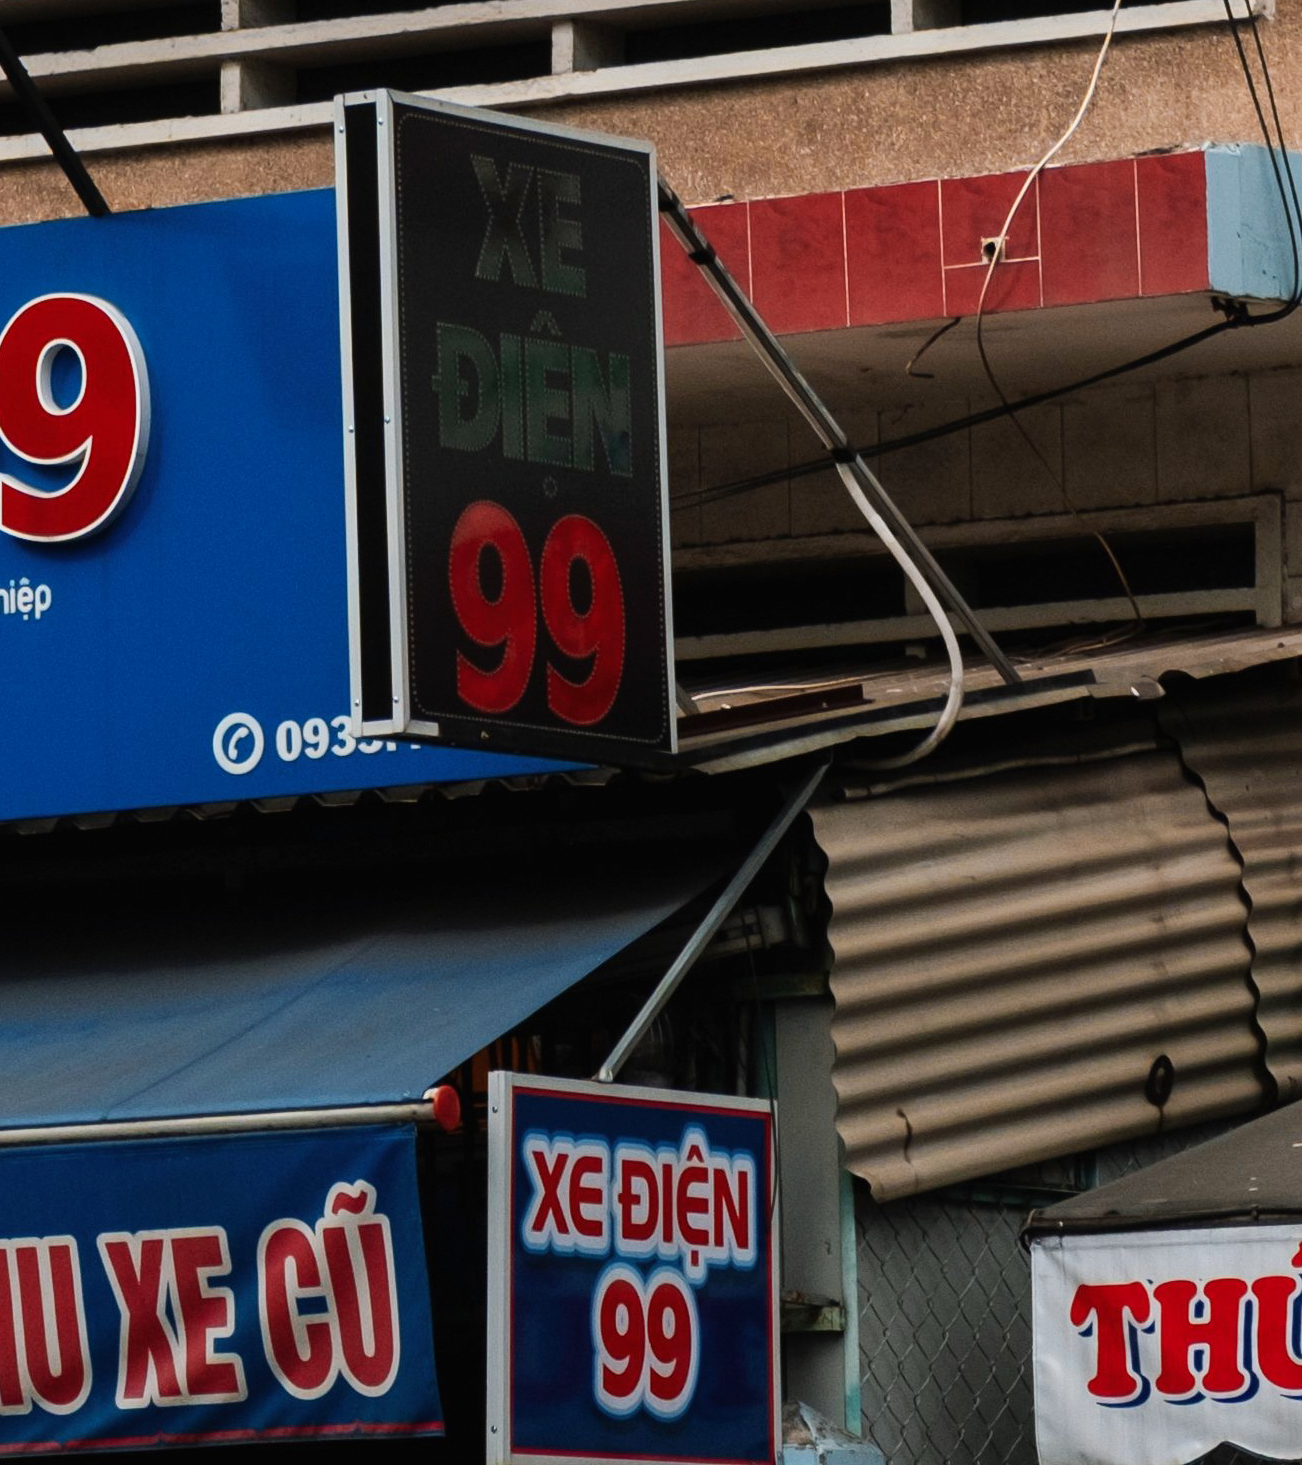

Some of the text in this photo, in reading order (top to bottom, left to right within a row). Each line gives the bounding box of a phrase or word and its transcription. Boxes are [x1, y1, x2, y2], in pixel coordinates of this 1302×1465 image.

[468, 152, 588, 299] XE
[430, 308, 635, 499] ĐIỆN
[448, 498, 627, 726] 99
[526, 1134, 753, 1274] XE ĐIỆN
[99, 1227, 247, 1408] XE
[258, 1181, 398, 1398] CŨ
[596, 1271, 697, 1408] 99
